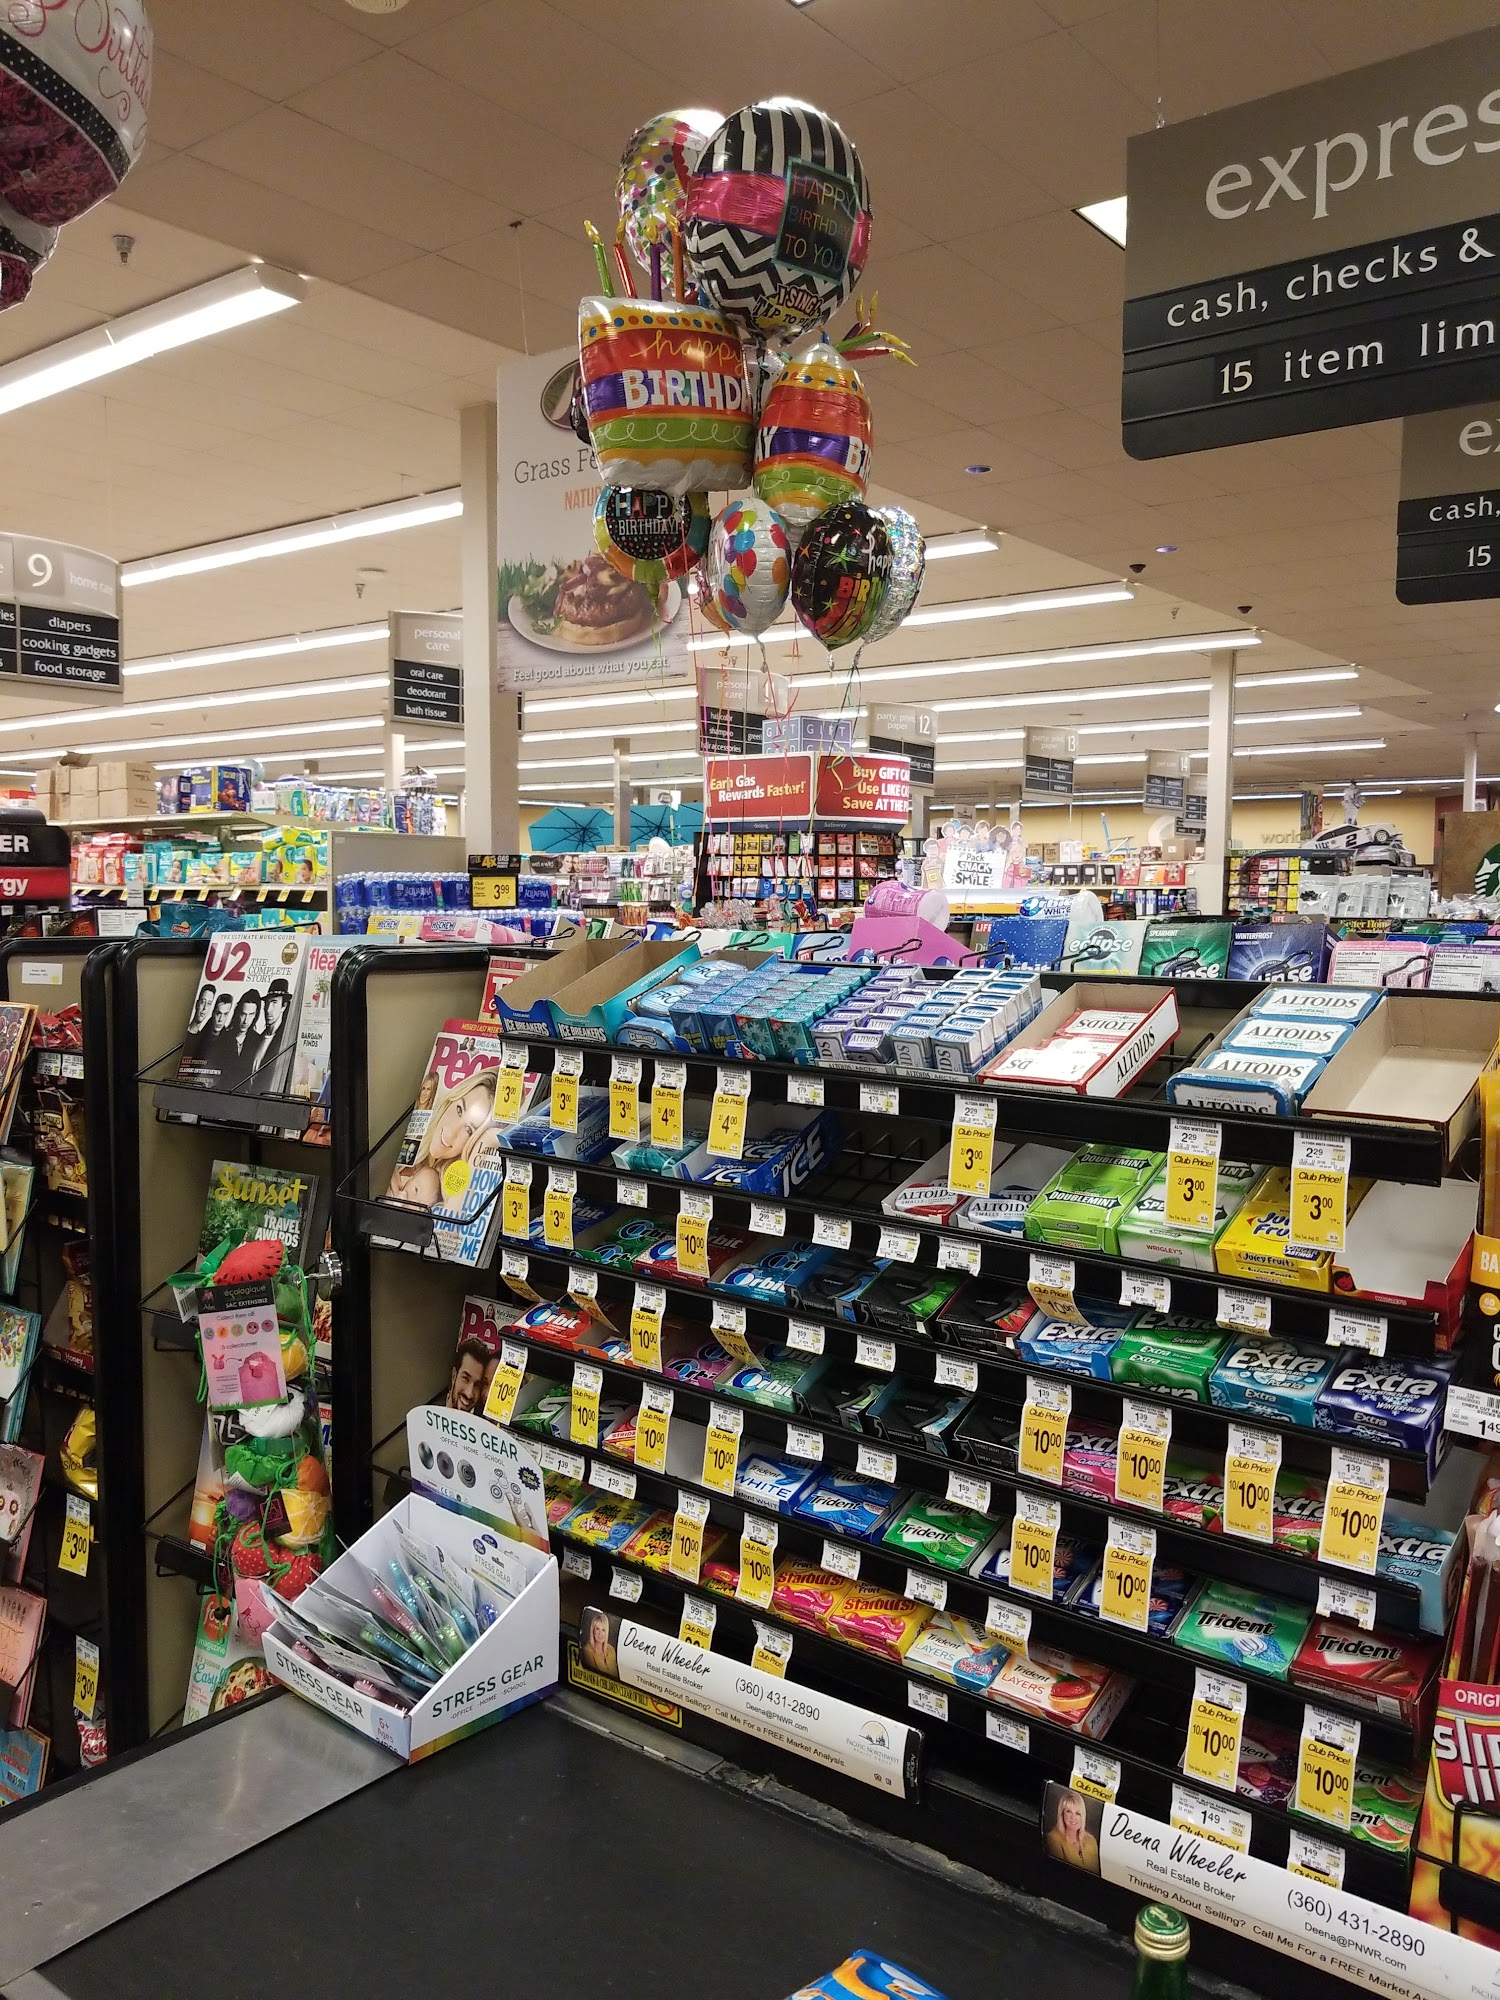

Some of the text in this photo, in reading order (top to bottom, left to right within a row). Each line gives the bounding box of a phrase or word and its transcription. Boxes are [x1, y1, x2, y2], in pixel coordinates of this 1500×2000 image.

[791, 172, 858, 211] HAPPY
[788, 205, 851, 240] BIRTHDAY
[785, 235, 845, 273] TO YOU
[1167, 227, 1496, 328] cash, checks &
[753, 297, 797, 325] TAP TO
[787, 287, 822, 317] SING!
[629, 330, 745, 377] happy
[1220, 320, 1496, 394] 15 item lim
[514, 457, 570, 484] Grass
[1429, 496, 1500, 522] cash,
[618, 519, 679, 536] BIRTHDAY!
[1467, 545, 1492, 567] 15
[28, 553, 53, 587] 9
[70, 572, 98, 591] home
[48, 617, 92, 633] diapers
[414, 629, 461, 641] personal
[22, 636, 117, 659] cooking gadgets
[426, 642, 450, 652] care
[34, 660, 106, 681] food storage
[410, 669, 444, 681] oral care
[513, 666, 534, 682] Feel
[535, 663, 563, 681] good
[564, 661, 595, 678] about
[597, 661, 626, 675] what
[628, 659, 650, 673] you
[406, 686, 447, 700] deodorant
[406, 704, 448, 718] bath tissue
[766, 720, 796, 738] GIFT
[806, 723, 846, 737] GIFT
[919, 713, 931, 735] 12
[1067, 735, 1076, 751] 13
[710, 774, 756, 791] Earn Gas
[853, 766, 900, 781] Buy GIFT
[718, 782, 806, 803] Rewards Faster!
[858, 781, 900, 796] Use LIKE
[842, 796, 905, 811] Save AT THE
[824, 821, 848, 829] Safeway
[966, 853, 985, 861] Pack
[957, 862, 992, 873] SNACK
[1069, 937, 1133, 952] eclipse
[1235, 931, 1274, 940] WINTERFROST
[205, 942, 251, 981] U2
[248, 966, 292, 975] COMPLETE
[251, 958, 268, 966] THE
[246, 974, 273, 982] STORY
[1272, 993, 1360, 1010] ALTOIDS
[503, 1017, 549, 1037] ICE BREAKERS
[557, 1022, 606, 1043] ICE BREAKERS
[1244, 1024, 1340, 1042] ALTOIDS
[1116, 1026, 1155, 1084] ALTOIDS
[1216, 1058, 1310, 1078] ALTOIDS
[958, 1128, 991, 1138] Club Price!
[782, 1123, 822, 1198] ICE
[1081, 1154, 1150, 1170] DOUBLEMINT
[1174, 1156, 1214, 1168] Club Price!
[214, 1165, 308, 1208] Sunset
[469, 1169, 500, 1190] HOW
[1050, 1191, 1120, 1208] DOUBLEMINT
[264, 1214, 301, 1234] TRAVEL
[1146, 1244, 1183, 1256] WRIGLEY'S
[1243, 1252, 1293, 1266] Juicy Fruit
[226, 1297, 268, 1308] SAC EXTENSIBLE
[1037, 1322, 1126, 1344] Extra
[1226, 1347, 1326, 1373] Extra
[1331, 1367, 1439, 1396] Extra
[1376, 1401, 1425, 1415] WINTERFRESH
[425, 1409, 518, 1462] STRESS GEAR
[809, 1493, 861, 1510] Trident
[1335, 1485, 1381, 1502] Club Price!
[900, 1522, 955, 1541] Trident
[776, 1571, 847, 1586] Starburst
[843, 1598, 917, 1611] Starburst
[1195, 1610, 1277, 1635] Trident
[624, 1627, 711, 1676] Deena Wheeler
[914, 1642, 956, 1662] LAYERS
[1315, 1633, 1402, 1661] Trident
[276, 1651, 365, 1720] STRESS GEAR
[431, 1654, 544, 1718] STRESS GEAR
[646, 1662, 704, 1691] Real Estate Broker
[1001, 1673, 1045, 1695] LAYERS
[735, 1677, 820, 1721] (360) 431-2890
[745, 1701, 809, 1733] Deena@PNWR.com
[1109, 1812, 1247, 1883] Deena Wheeler
[1146, 1859, 1236, 1902] Real Estate Broker
[1287, 1888, 1425, 1957] (360) 431-2890
[1128, 1874, 1410, 1997] Thinking About Selling? Call Me For a FREE Market
[1304, 1921, 1407, 1972] Deena@PNWR.com
